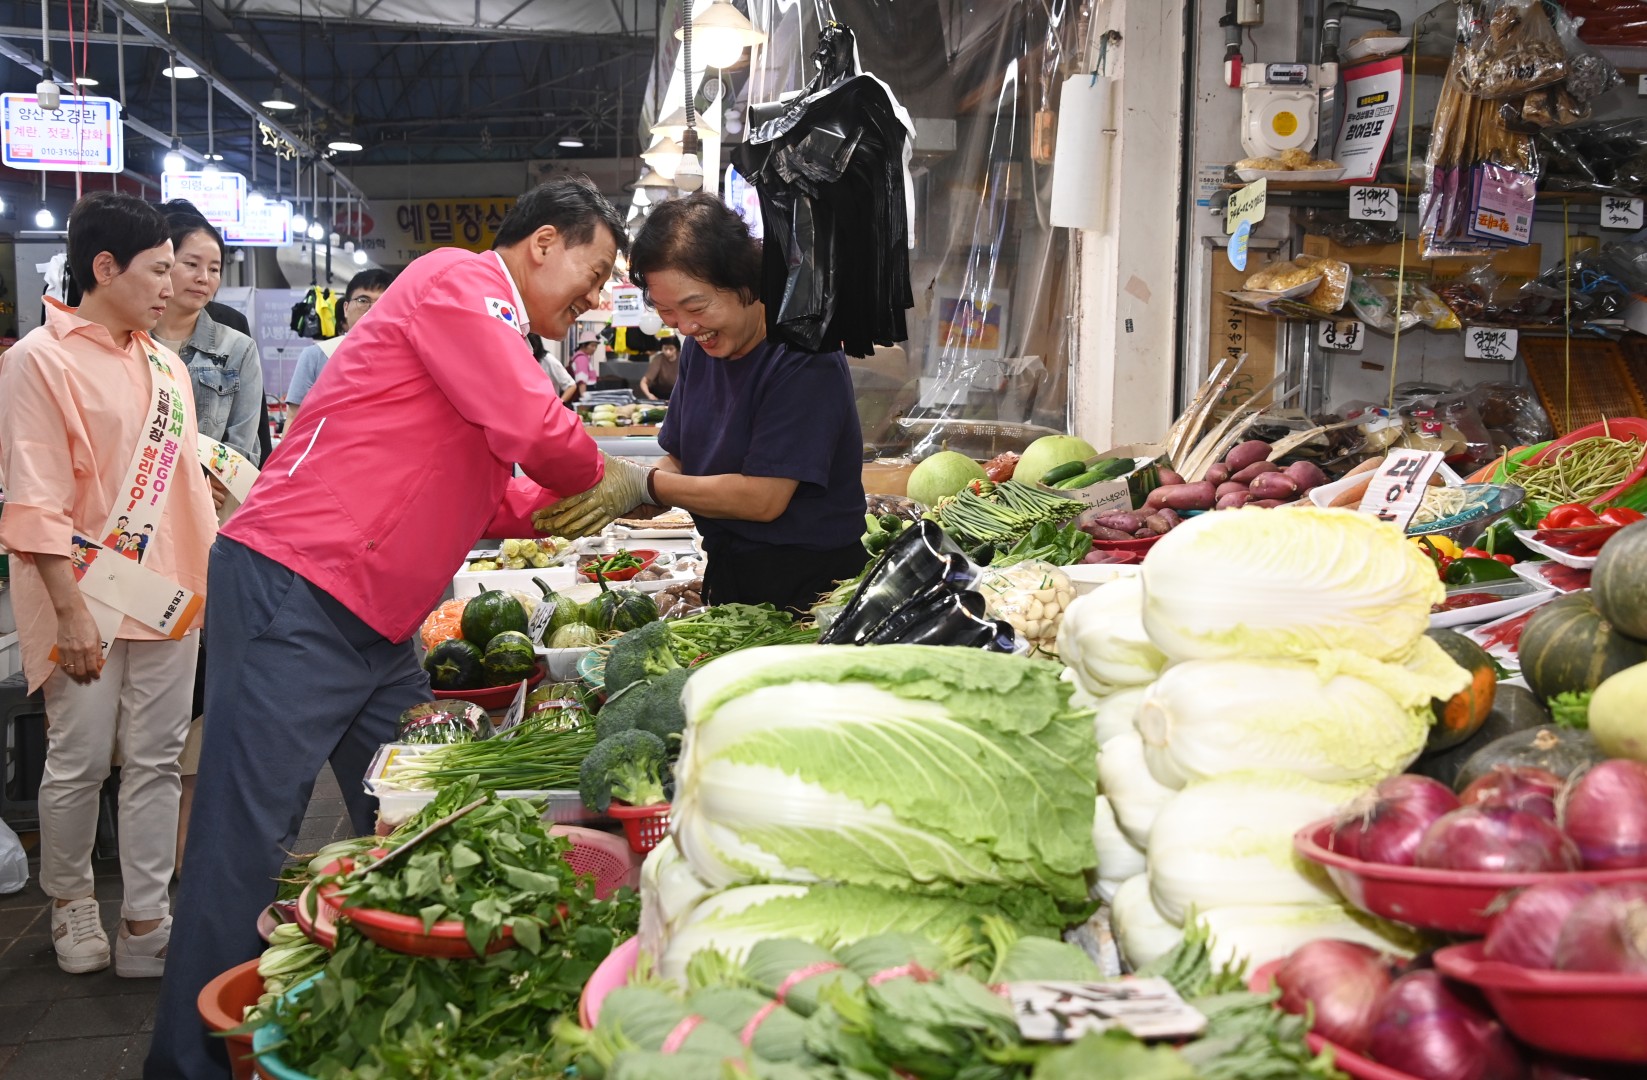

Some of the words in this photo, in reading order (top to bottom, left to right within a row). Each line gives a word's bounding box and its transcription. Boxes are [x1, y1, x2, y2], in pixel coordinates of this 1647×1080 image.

[18, 107, 44, 121] 양산
[50, 108, 97, 125] 오경란
[1345, 119, 1384, 141] 참여점포
[41, 147, 99, 157] 010-3156-2024
[1322, 320, 1360, 344] 상황
[149, 387, 170, 443] 전통시장
[168, 386, 184, 438] 시장에서
[126, 445, 158, 512] 살리GO!
[150, 439, 178, 506] 장보GO!
[163, 590, 185, 620] 해운대구
